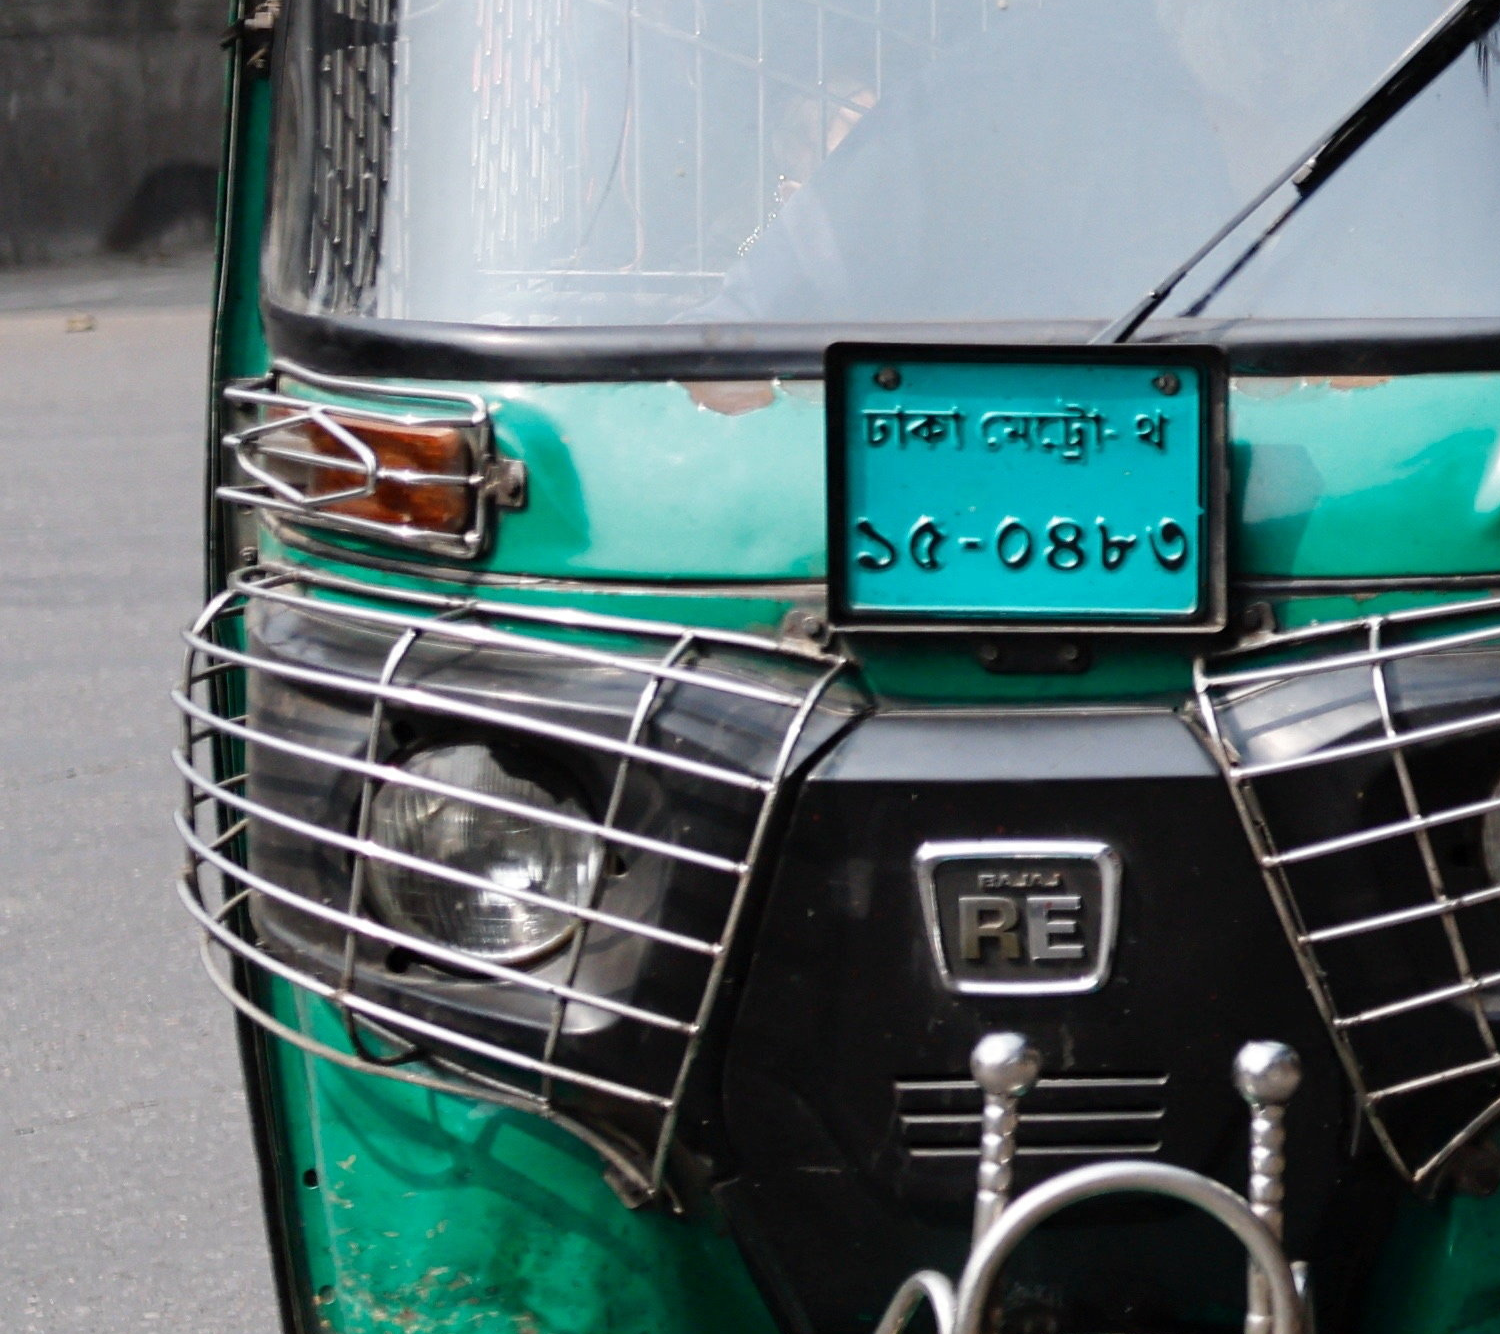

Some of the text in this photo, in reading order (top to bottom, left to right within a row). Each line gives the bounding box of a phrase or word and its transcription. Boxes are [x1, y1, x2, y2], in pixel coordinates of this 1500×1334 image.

[862, 405, 965, 450] ঢাকা
[1134, 408, 1169, 453] থ
[854, 513, 1189, 572] ১৫-০৪৮৩
[977, 871, 1063, 889] BAJAJ
[958, 893, 1086, 961] RE
